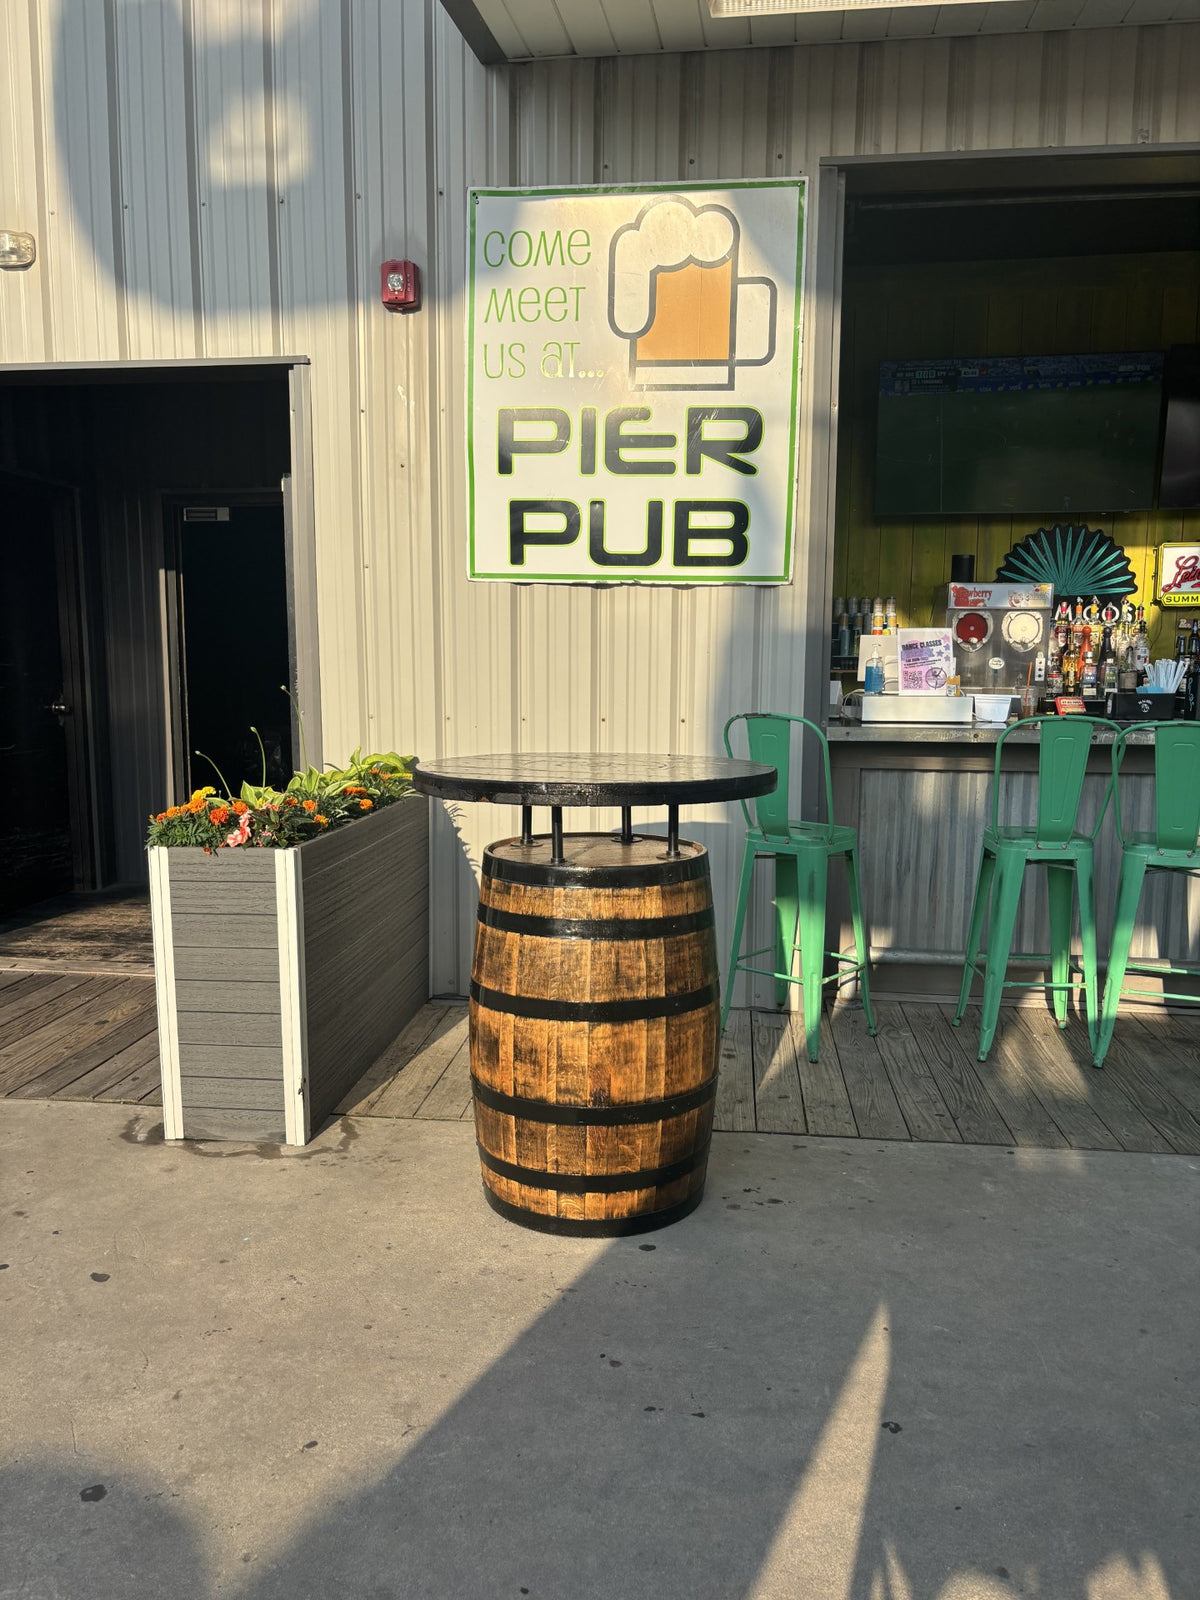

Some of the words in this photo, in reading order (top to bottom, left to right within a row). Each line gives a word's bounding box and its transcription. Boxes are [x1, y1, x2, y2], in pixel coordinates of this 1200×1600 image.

[483, 342, 526, 379] US
[496, 406, 765, 477] PIER
[507, 499, 751, 568] PUB
